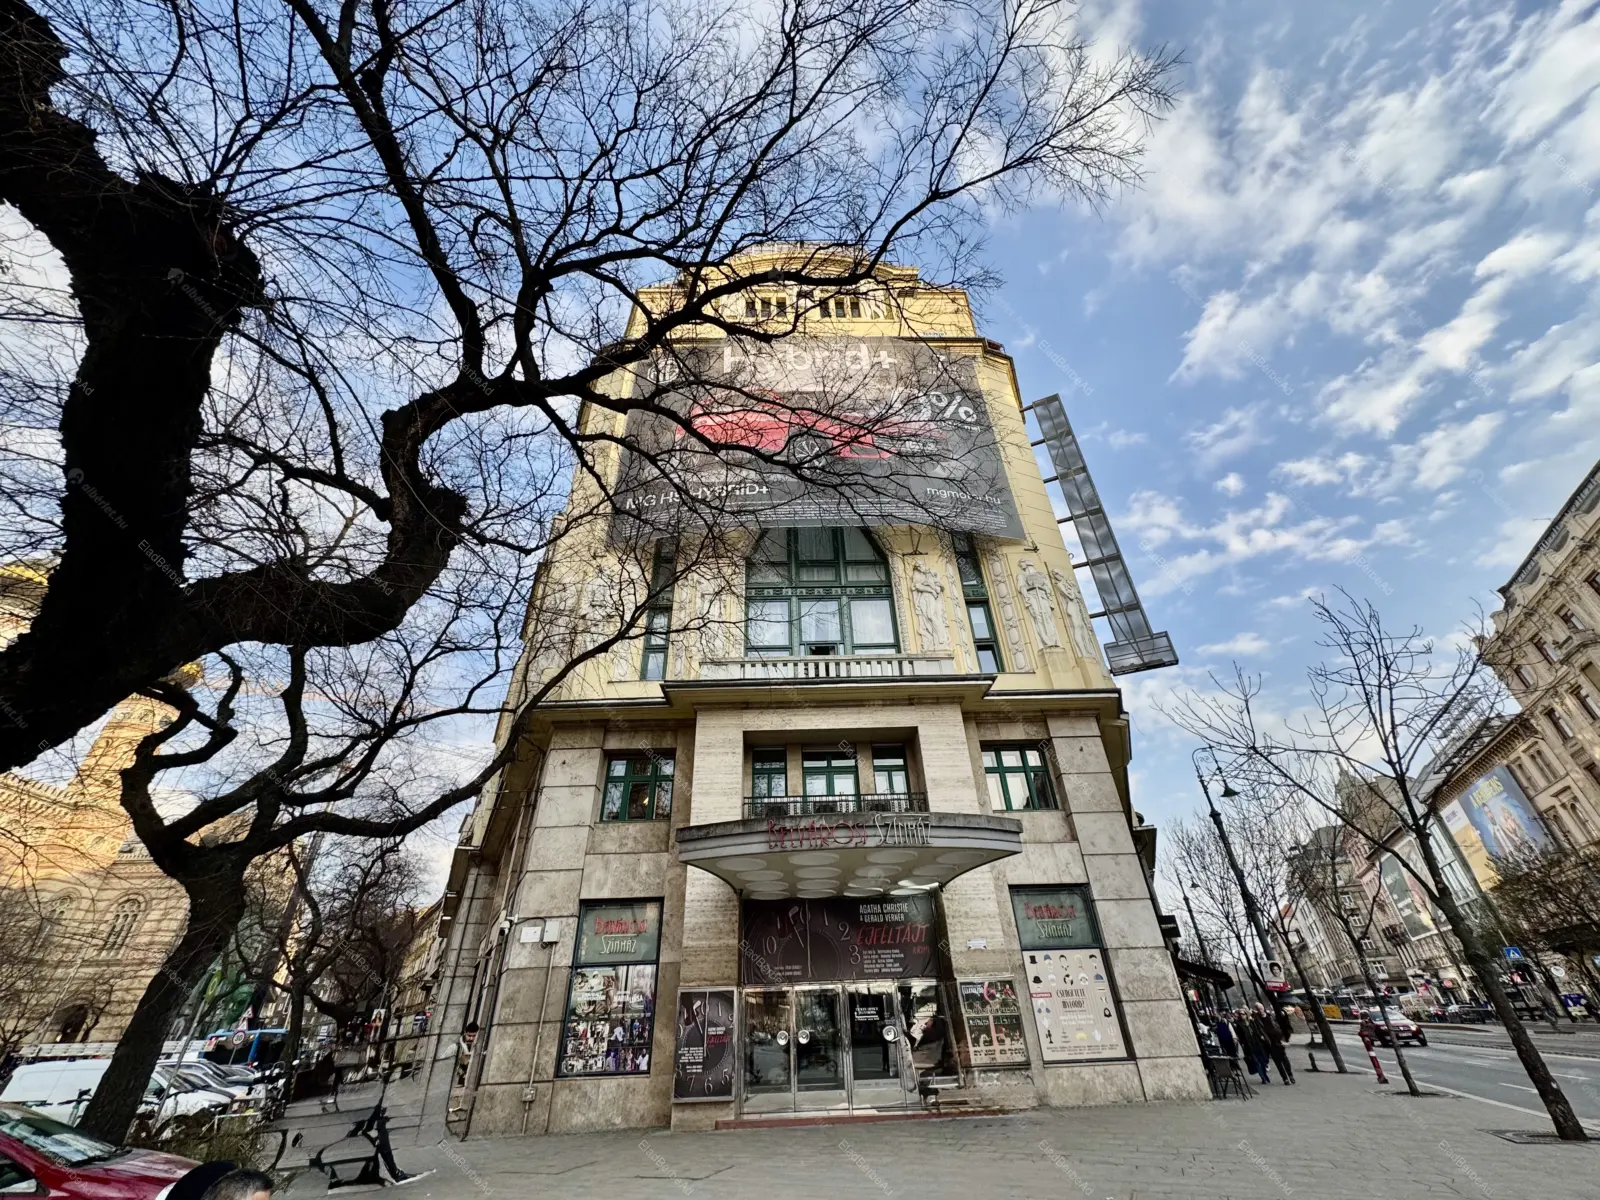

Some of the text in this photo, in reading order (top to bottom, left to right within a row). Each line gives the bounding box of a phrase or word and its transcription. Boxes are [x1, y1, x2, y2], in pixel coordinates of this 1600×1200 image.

[625, 494, 657, 510] MG
[926, 487, 1001, 505] mgmotor.hu
[859, 903, 909, 914] AGATHA CHRISTIE
[864, 914, 883, 923] GERALD
[885, 913, 905, 922] VERNER
[838, 921, 851, 941] 2
[857, 922, 930, 946] ÉJFÉLTÁJT
[848, 944, 861, 965] 3
[704, 1077, 713, 1094] 6
